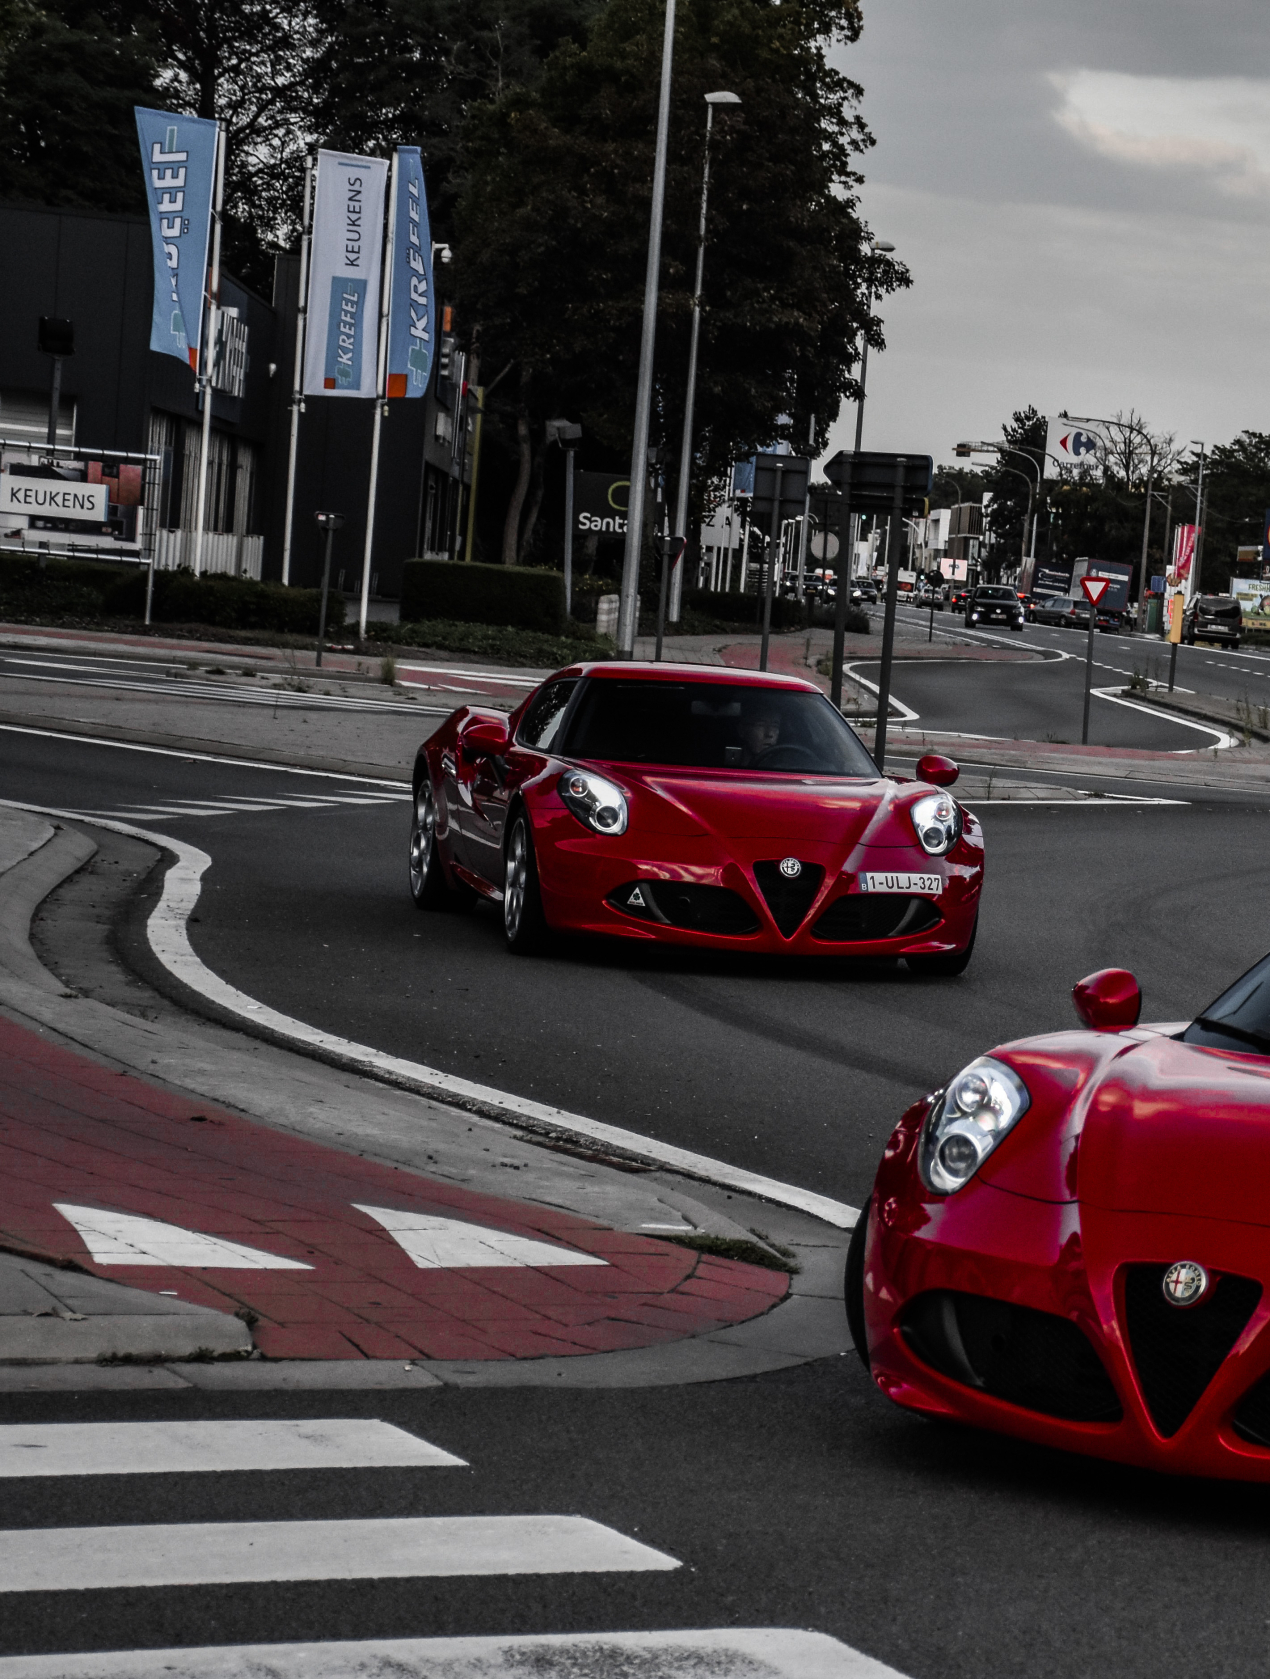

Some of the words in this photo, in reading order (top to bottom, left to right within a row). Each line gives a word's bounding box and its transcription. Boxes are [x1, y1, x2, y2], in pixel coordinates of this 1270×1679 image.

[344, 176, 363, 268] KEUKENS
[1052, 459, 1099, 471] Carrefour
[10, 487, 96, 511] KEUKENS
[869, 875, 941, 891] 1-ULJ-327
